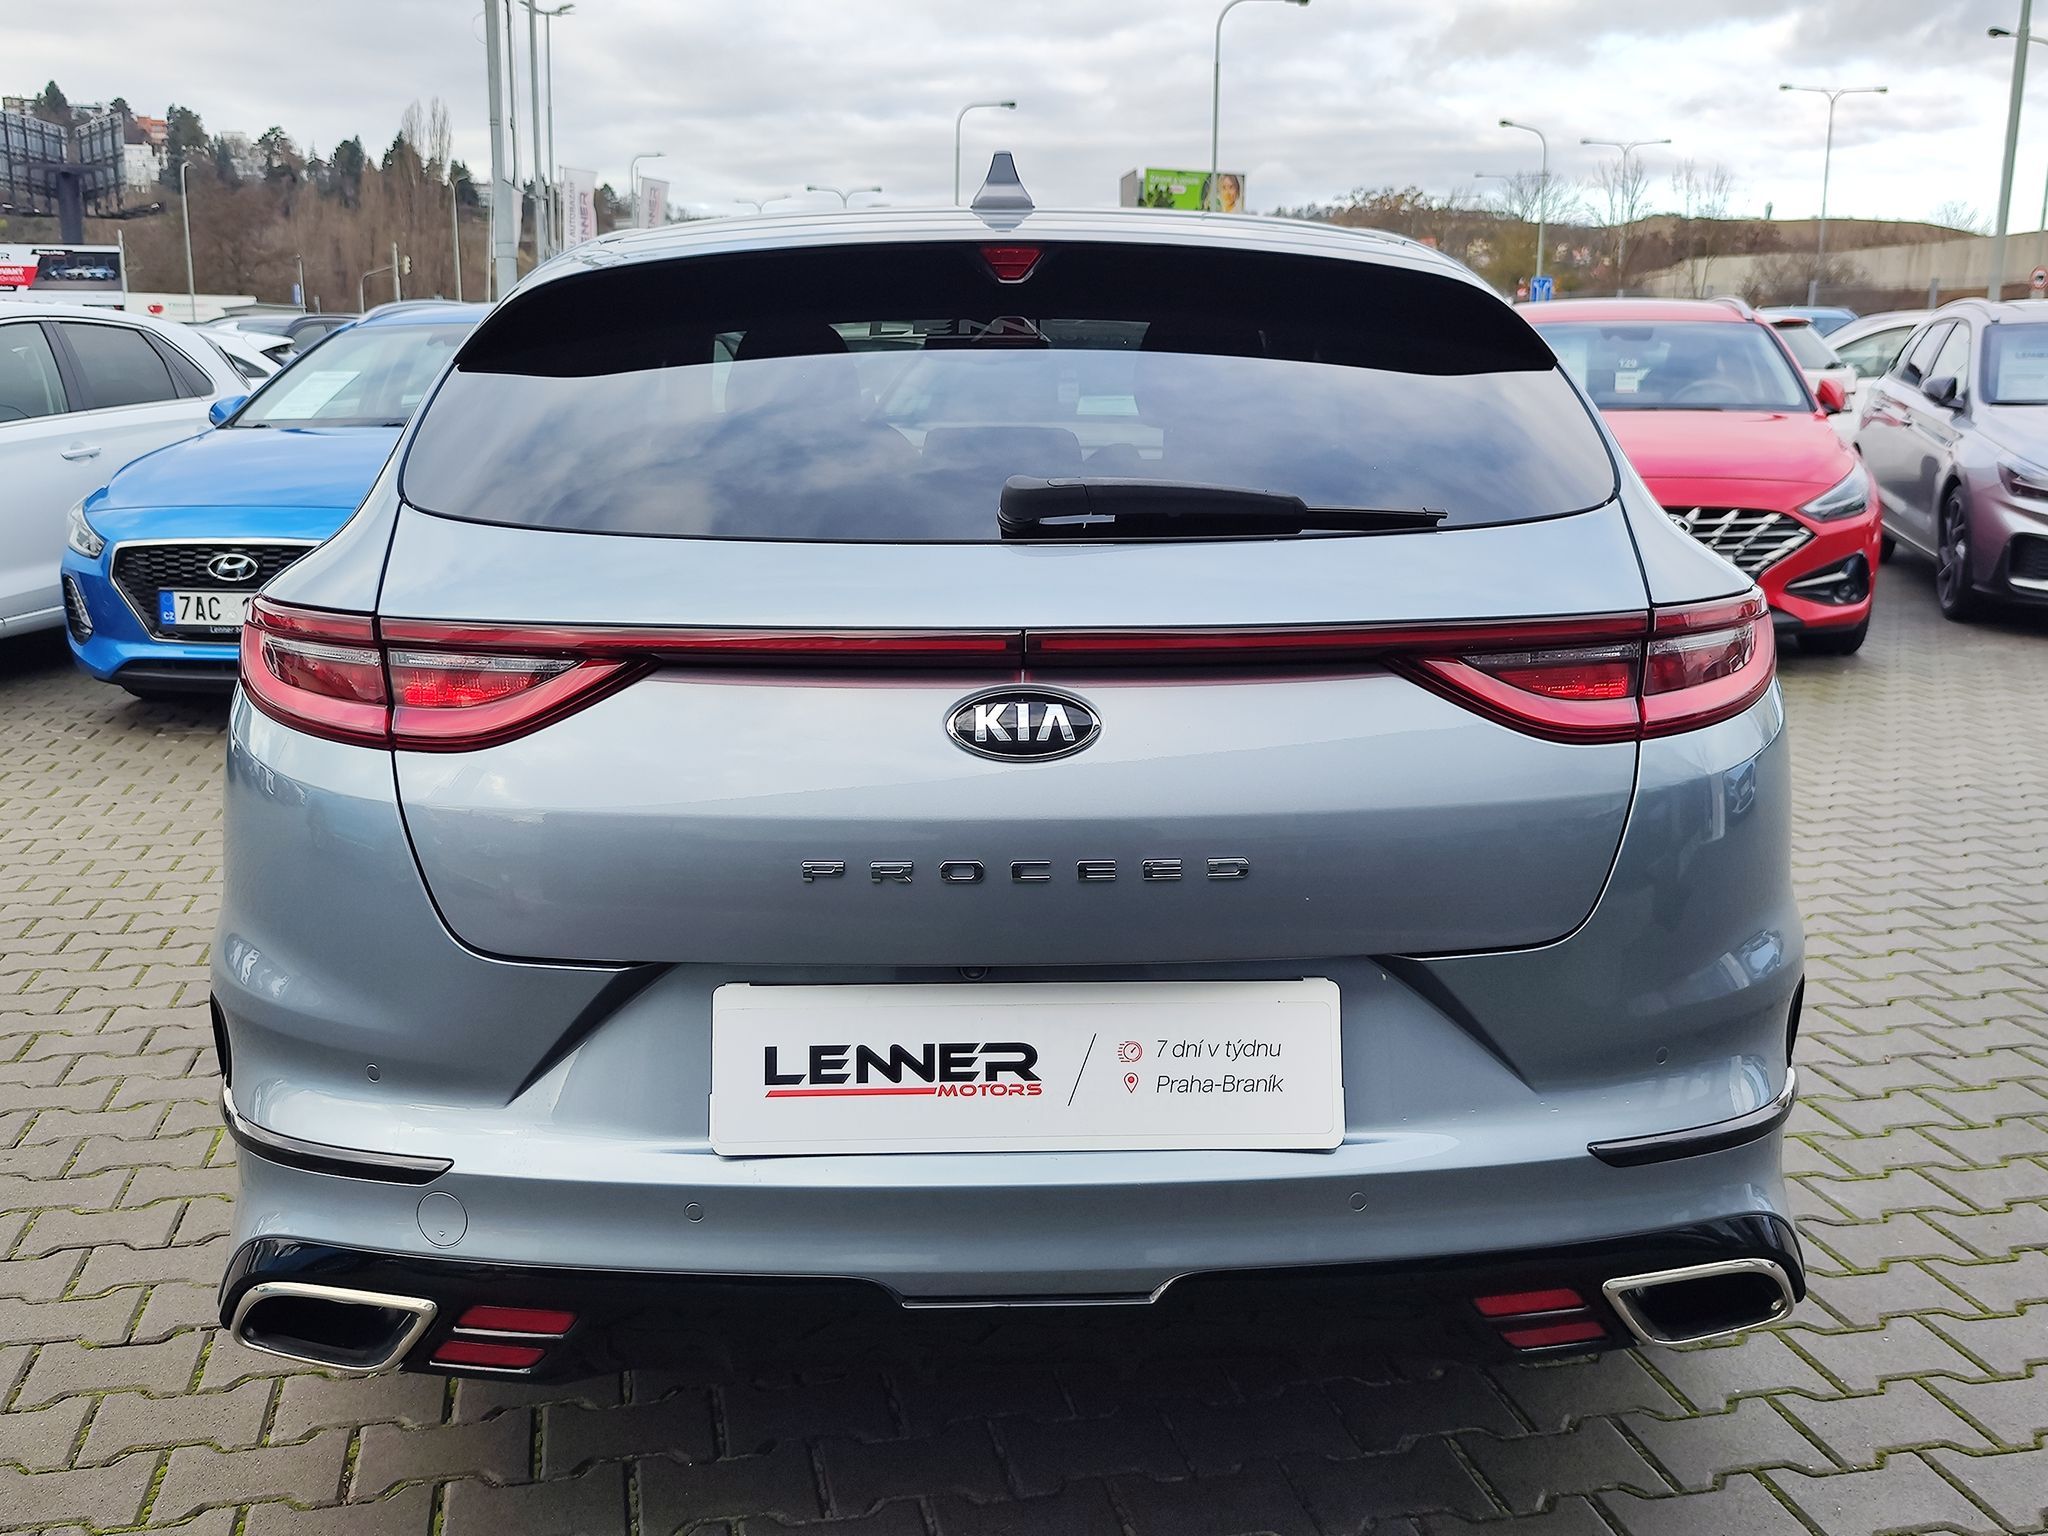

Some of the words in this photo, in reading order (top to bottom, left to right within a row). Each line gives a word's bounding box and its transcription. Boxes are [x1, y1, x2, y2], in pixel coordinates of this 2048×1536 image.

[163, 612, 176, 620] CZ
[973, 703, 1076, 742] KIA
[800, 857, 1250, 884] PROCEED
[1156, 1039, 1168, 1058] 7
[1172, 1039, 1204, 1058] dní
[1208, 1043, 1220, 1058] v
[1225, 1039, 1282, 1062] týdnu
[764, 1042, 1042, 1085] LENNER
[937, 1083, 1042, 1098] MOTORS
[1156, 1074, 1284, 1094] Praha-Braník
